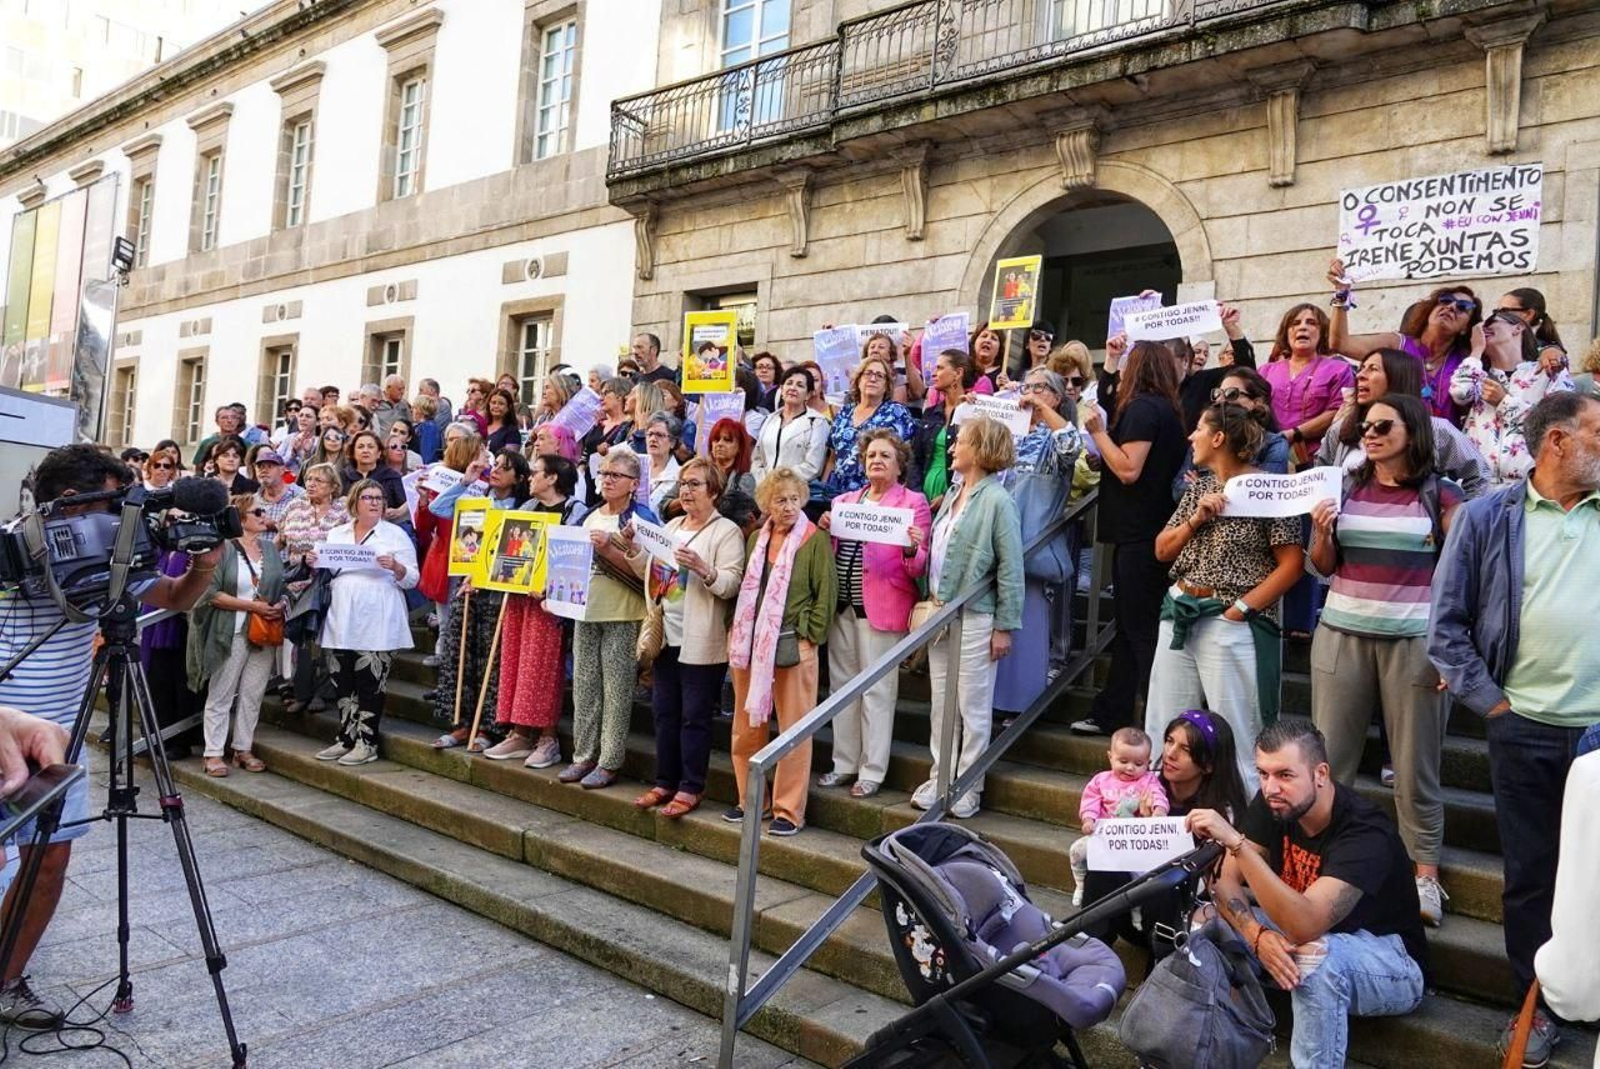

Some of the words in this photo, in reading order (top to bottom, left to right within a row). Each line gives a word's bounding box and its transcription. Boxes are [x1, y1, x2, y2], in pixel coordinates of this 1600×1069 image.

[1343, 193, 1359, 211] O
[1425, 197, 1477, 219] NON
[1489, 194, 1524, 212] SE
[1441, 216, 1472, 230] #EU
[1372, 221, 1436, 242] TOCA
[1343, 242, 1412, 269] IRENE
[1419, 228, 1530, 260] XUNTAS
[1400, 250, 1531, 274] PODEMOS
[1245, 478, 1297, 489] CONTIGO
[1248, 490, 1273, 500] POR
[1277, 487, 1314, 500] TODAS!!
[844, 511, 878, 522] CONTIGO
[845, 521, 861, 530] POR
[1105, 824, 1147, 835] CONTIGO
[1108, 839, 1128, 850] POR
[1130, 839, 1169, 850] TODAS!!
